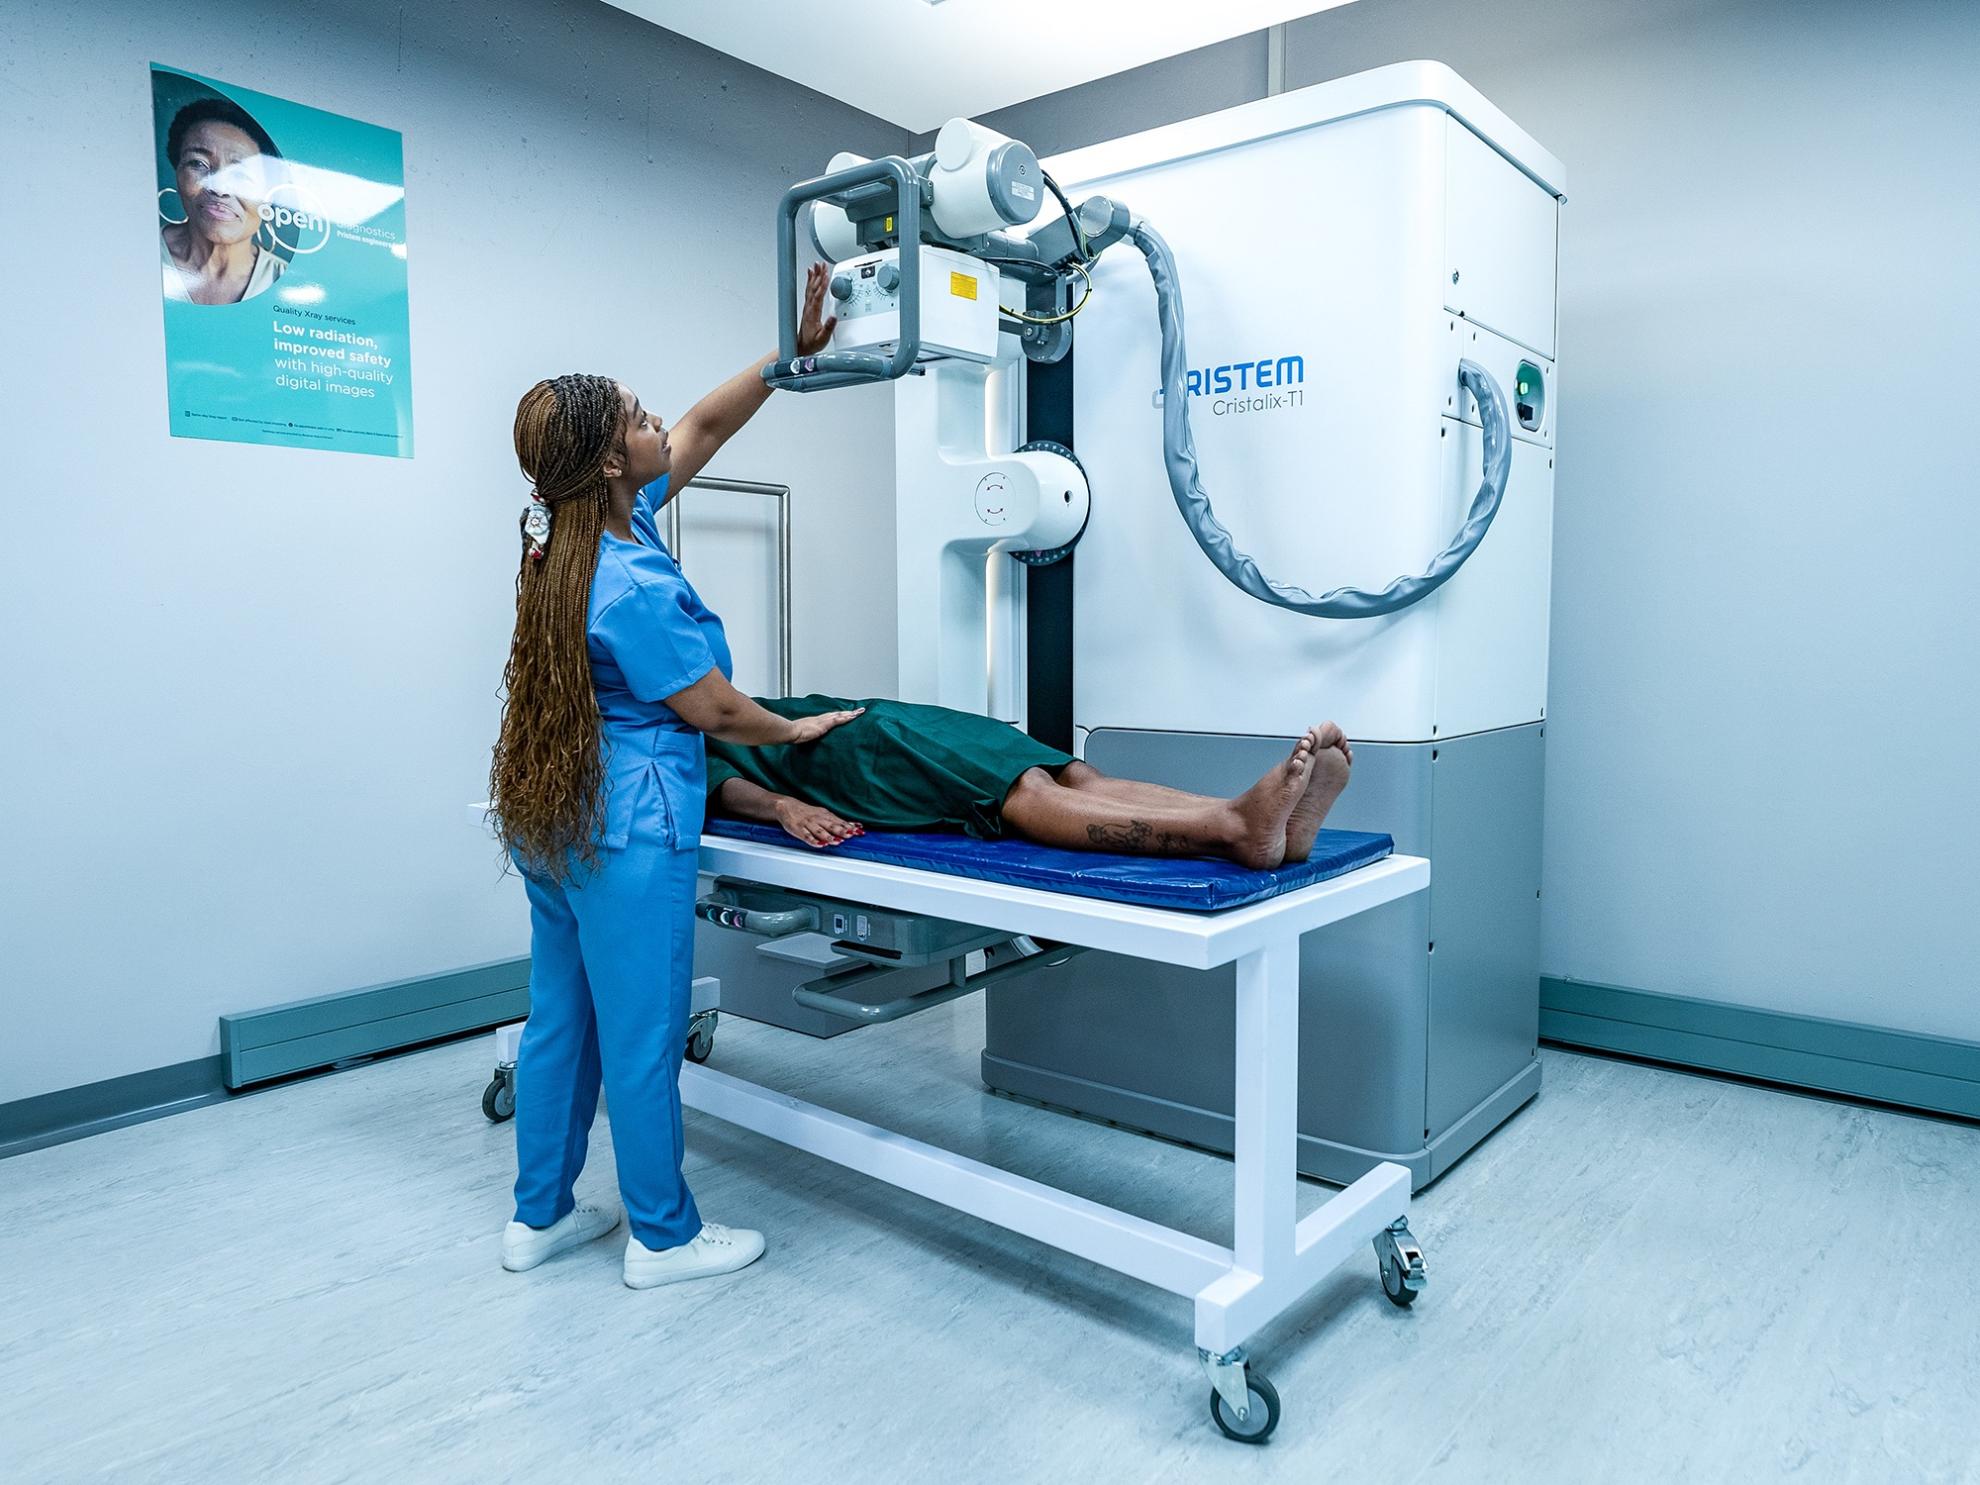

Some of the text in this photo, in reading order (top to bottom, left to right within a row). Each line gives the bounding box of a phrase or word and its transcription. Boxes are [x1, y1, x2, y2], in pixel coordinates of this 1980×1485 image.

[257, 203, 323, 233] open
[272, 304, 356, 326] Quality Xray services
[272, 320, 378, 351] Low radiation,
[273, 337, 392, 368] improved safety
[274, 357, 394, 385] with high-quality
[1160, 355, 1304, 397] RISTEM
[275, 374, 376, 398] digital images
[1212, 389, 1304, 416] Cristalix-T1
